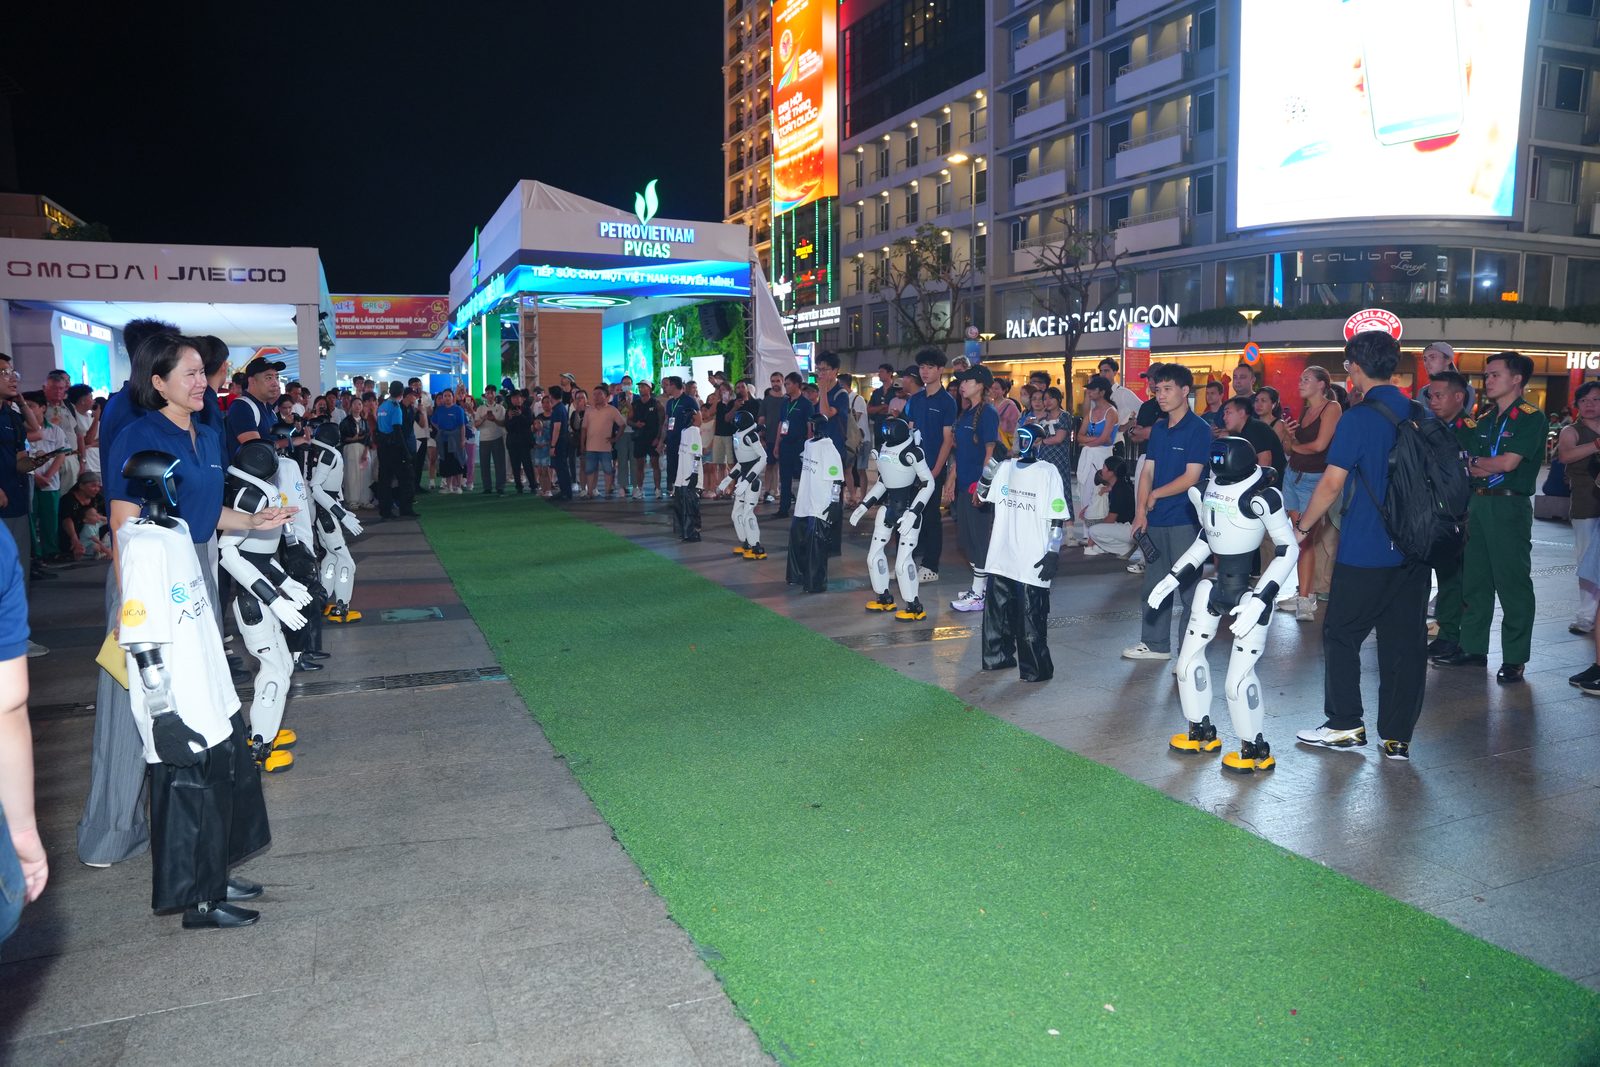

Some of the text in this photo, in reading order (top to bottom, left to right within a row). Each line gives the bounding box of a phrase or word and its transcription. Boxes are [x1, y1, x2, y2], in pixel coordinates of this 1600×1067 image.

[600, 222, 694, 243] PETROVIETNAM
[7, 261, 286, 282] OMODA JAECOO
[647, 273, 669, 284] NAM
[1006, 315, 1056, 339] PALACE
[1108, 303, 1180, 331] SAIGON
[1347, 310, 1399, 330] HIGHLANDS
[1566, 351, 1600, 370] HIG
